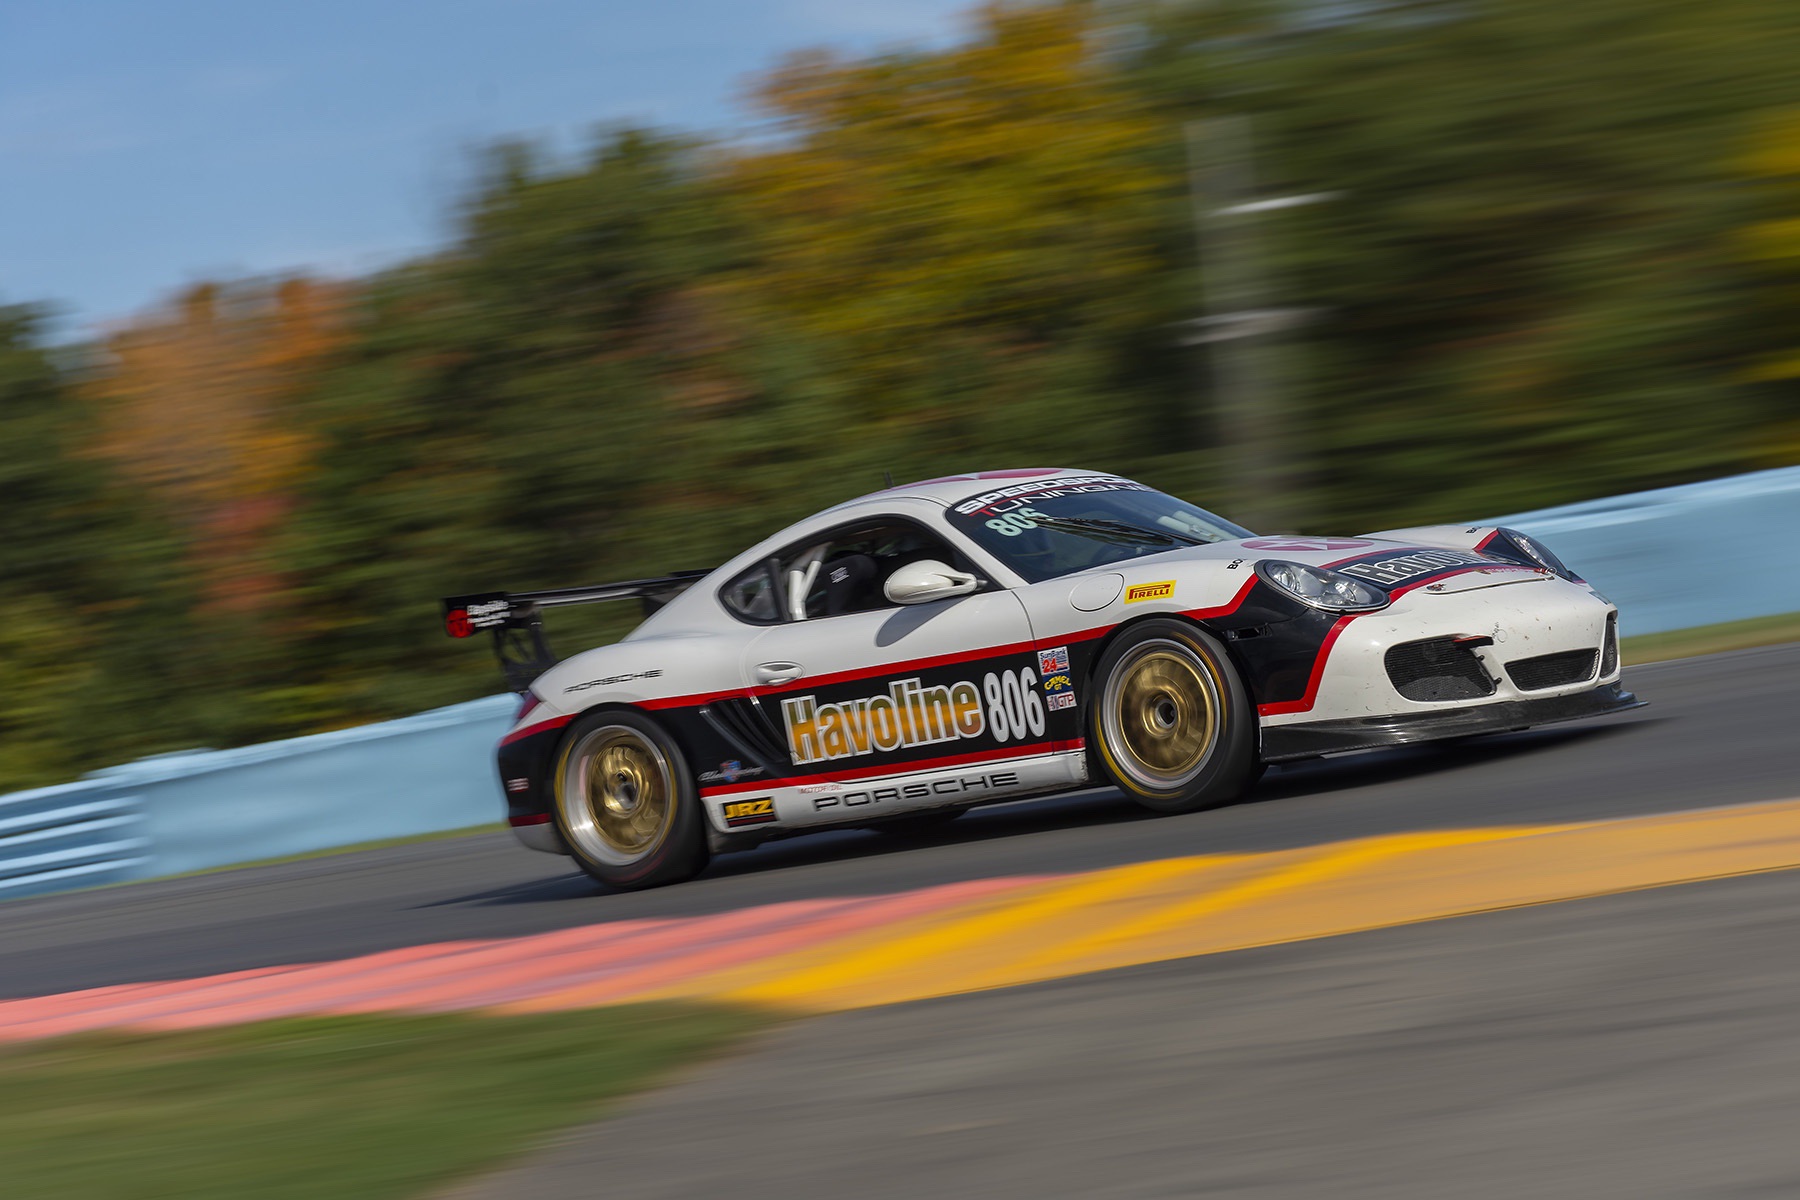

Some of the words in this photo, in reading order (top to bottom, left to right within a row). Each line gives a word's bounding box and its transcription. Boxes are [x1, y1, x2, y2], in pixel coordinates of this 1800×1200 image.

[954, 475, 1142, 514] SPEEDSPO
[1338, 551, 1521, 585] Havo
[1128, 583, 1171, 600] PIRELLI
[1042, 657, 1057, 674] 24
[563, 669, 663, 694] PORSCHE
[1044, 675, 1072, 690] CAMEL
[780, 676, 986, 766] Havoline
[983, 666, 1046, 743] 806
[812, 772, 1019, 812] PORSCHE
[724, 799, 774, 819] JRZ
